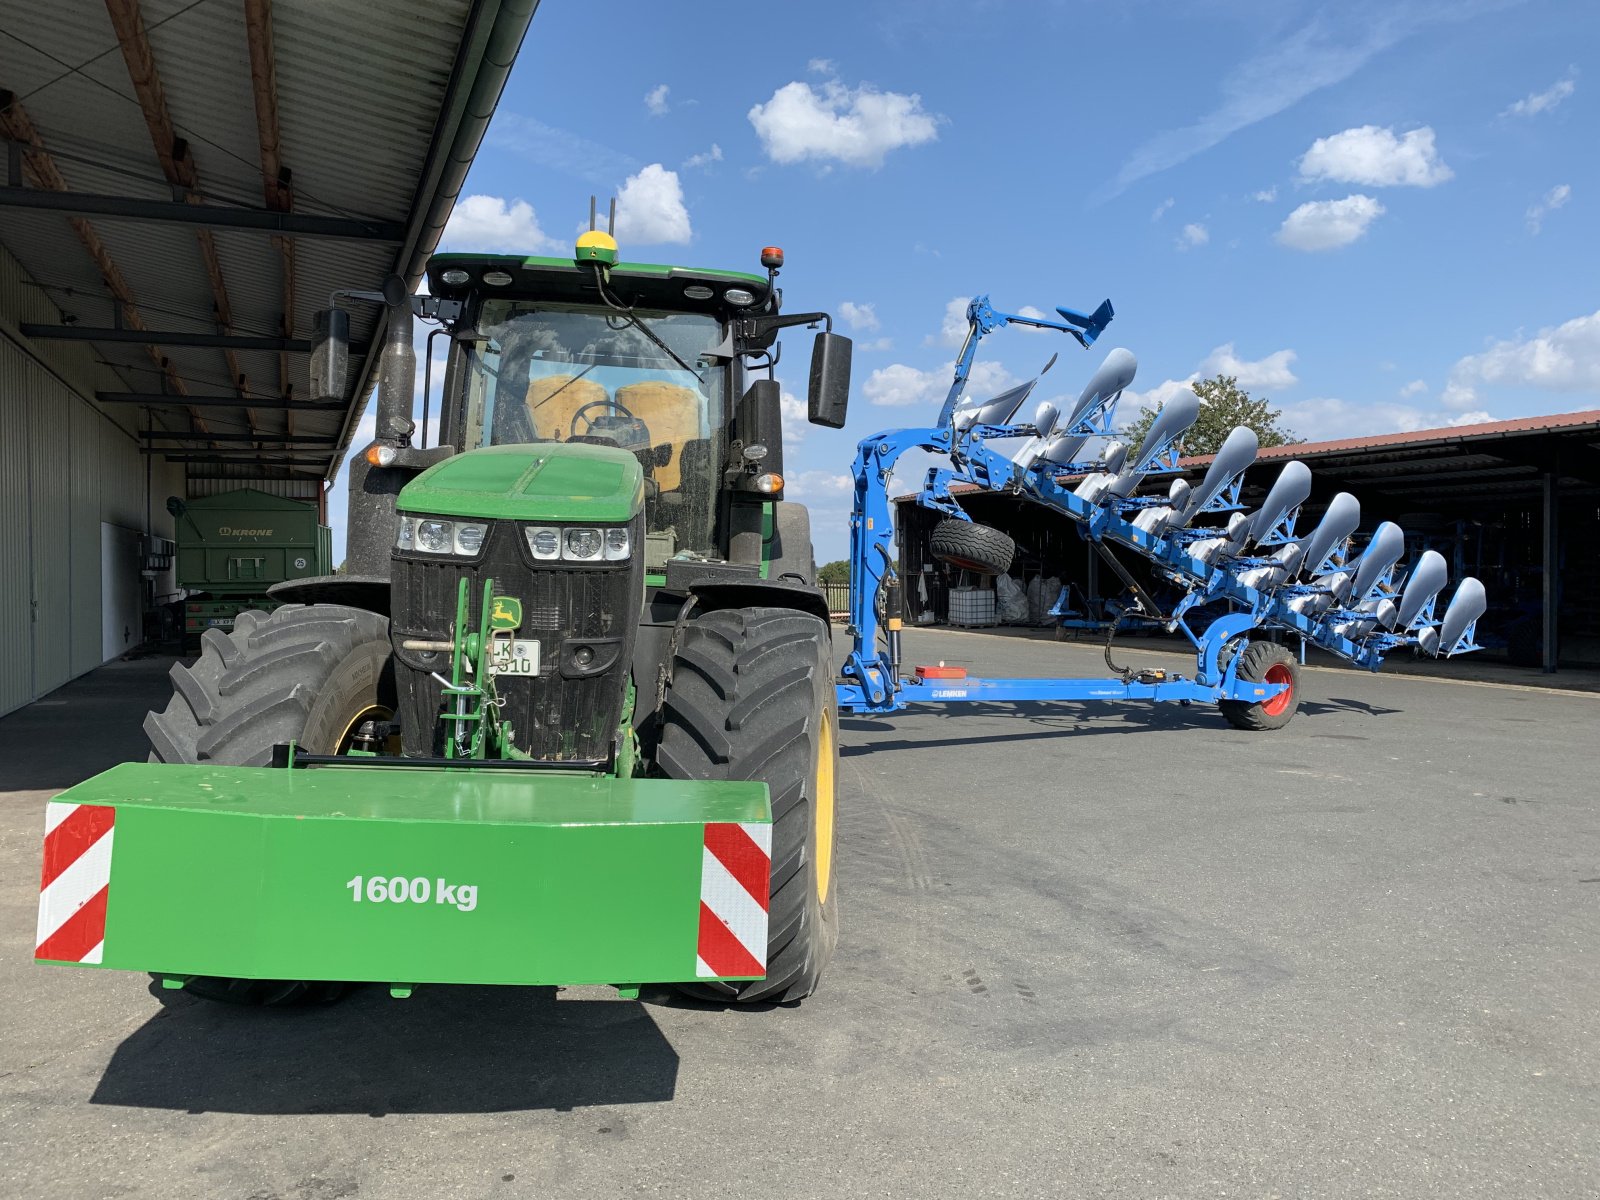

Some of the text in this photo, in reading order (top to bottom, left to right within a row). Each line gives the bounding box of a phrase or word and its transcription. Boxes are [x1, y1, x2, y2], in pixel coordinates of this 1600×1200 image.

[296, 559, 305, 567] 25
[939, 690, 967, 698] LEMKEN
[346, 875, 478, 912] 1600 kg
